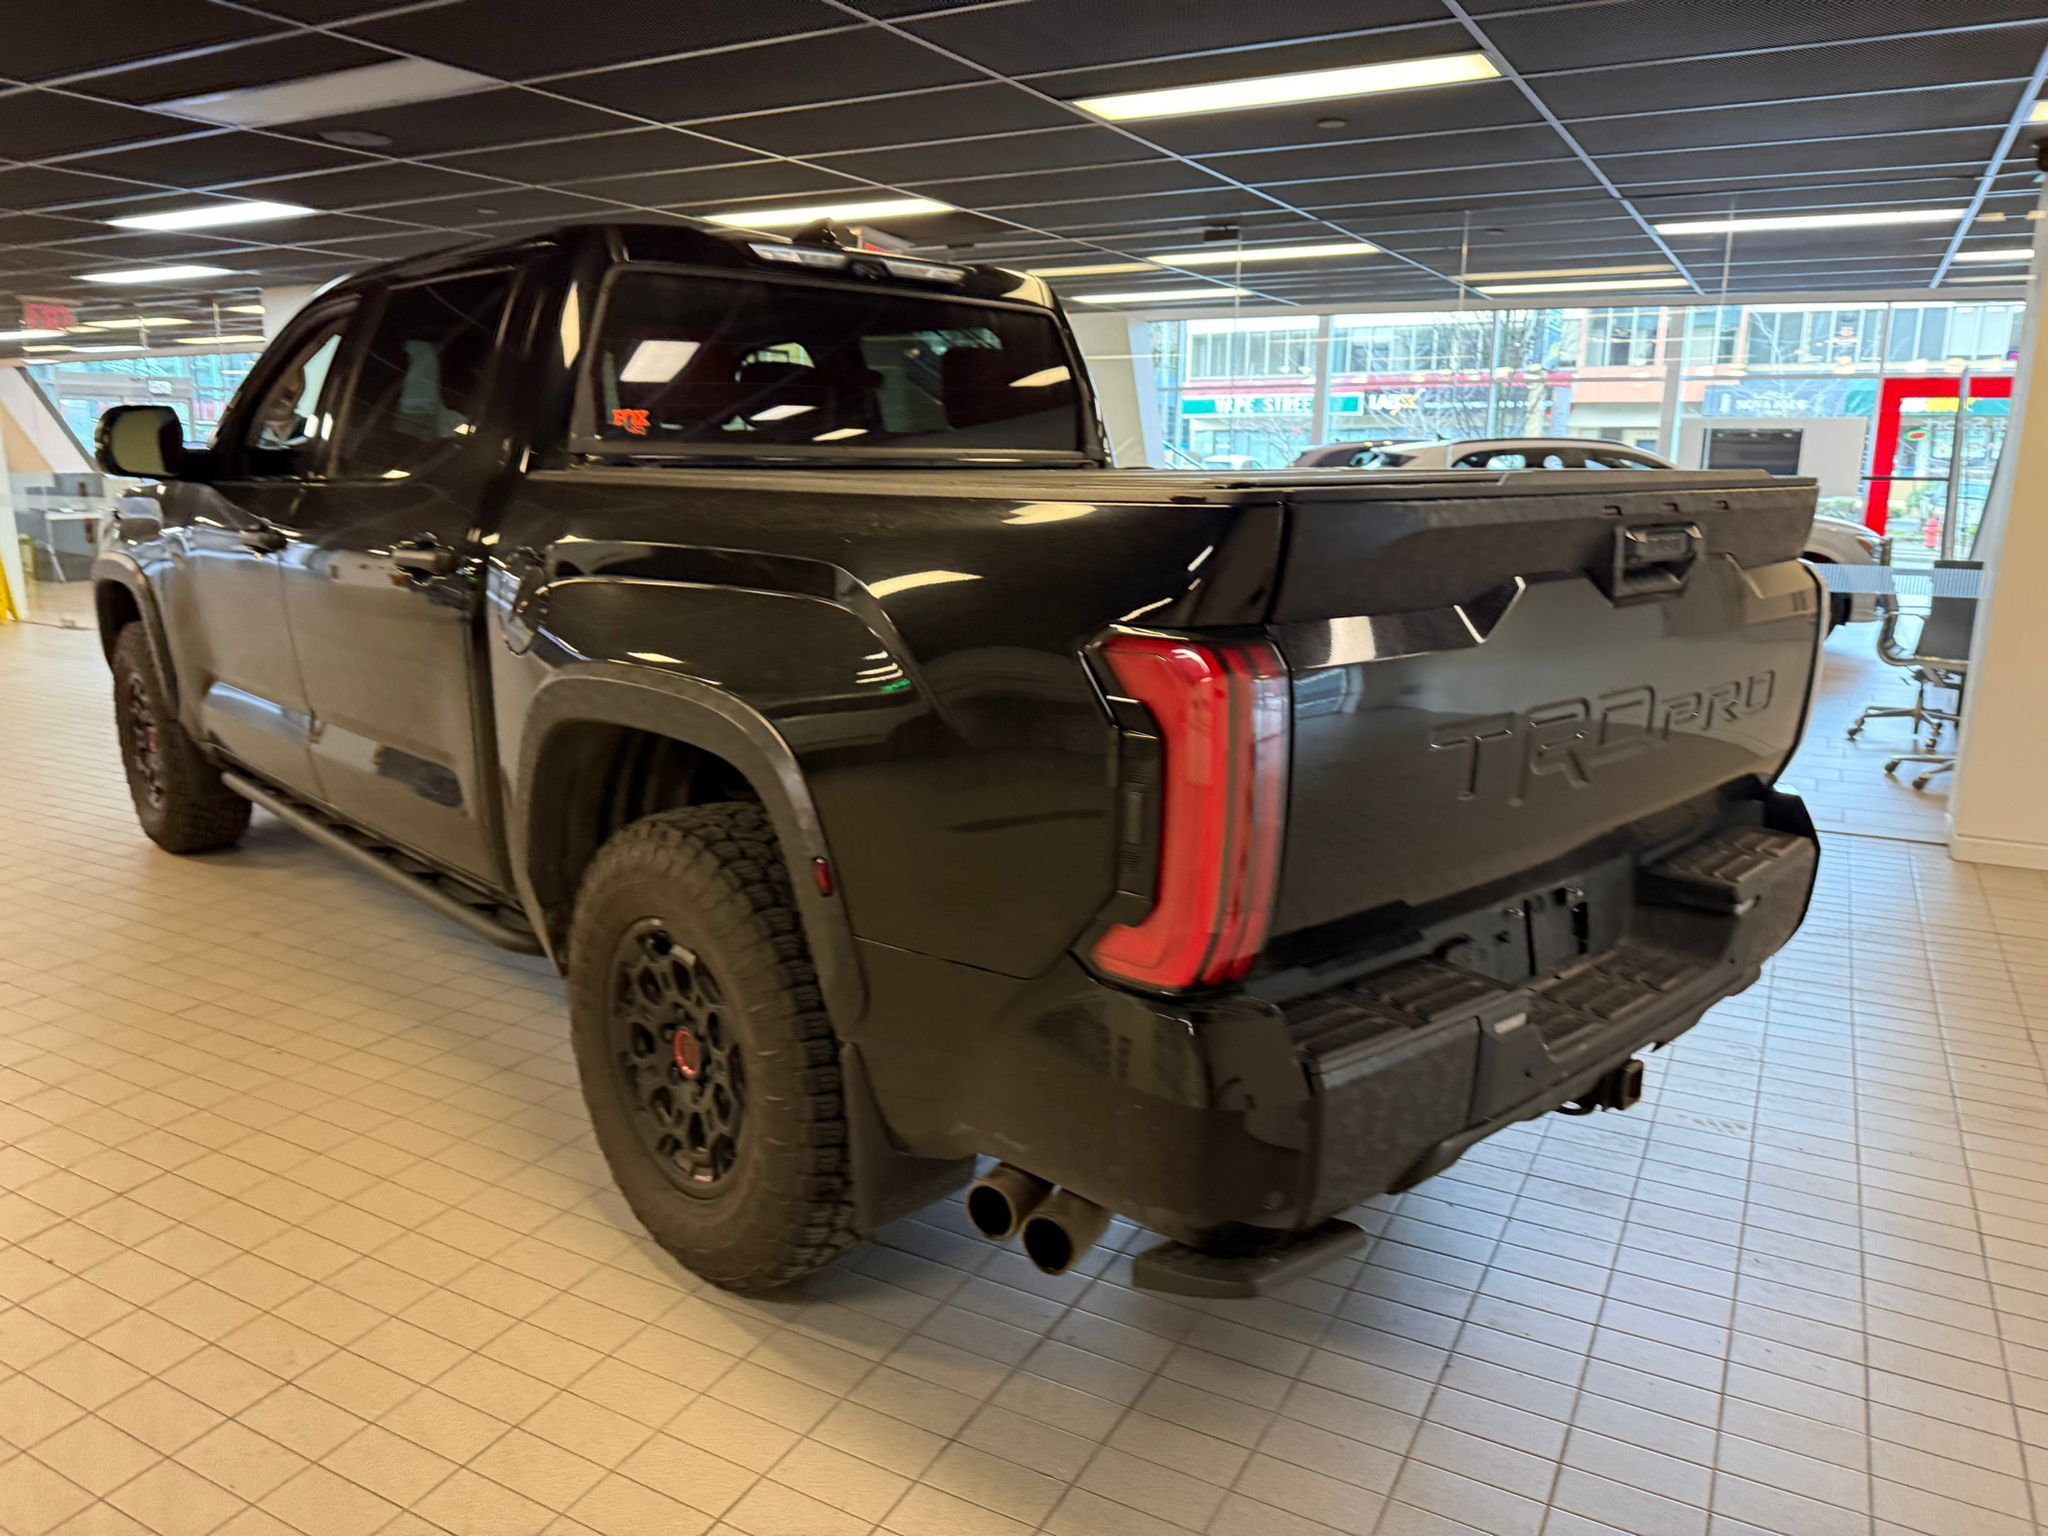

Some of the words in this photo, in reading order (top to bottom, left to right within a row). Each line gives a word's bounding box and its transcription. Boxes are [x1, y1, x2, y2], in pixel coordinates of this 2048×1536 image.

[1263, 397, 1313, 413] STREE
[1430, 684, 1657, 807] TRD
[1662, 669, 1776, 742] PRO
